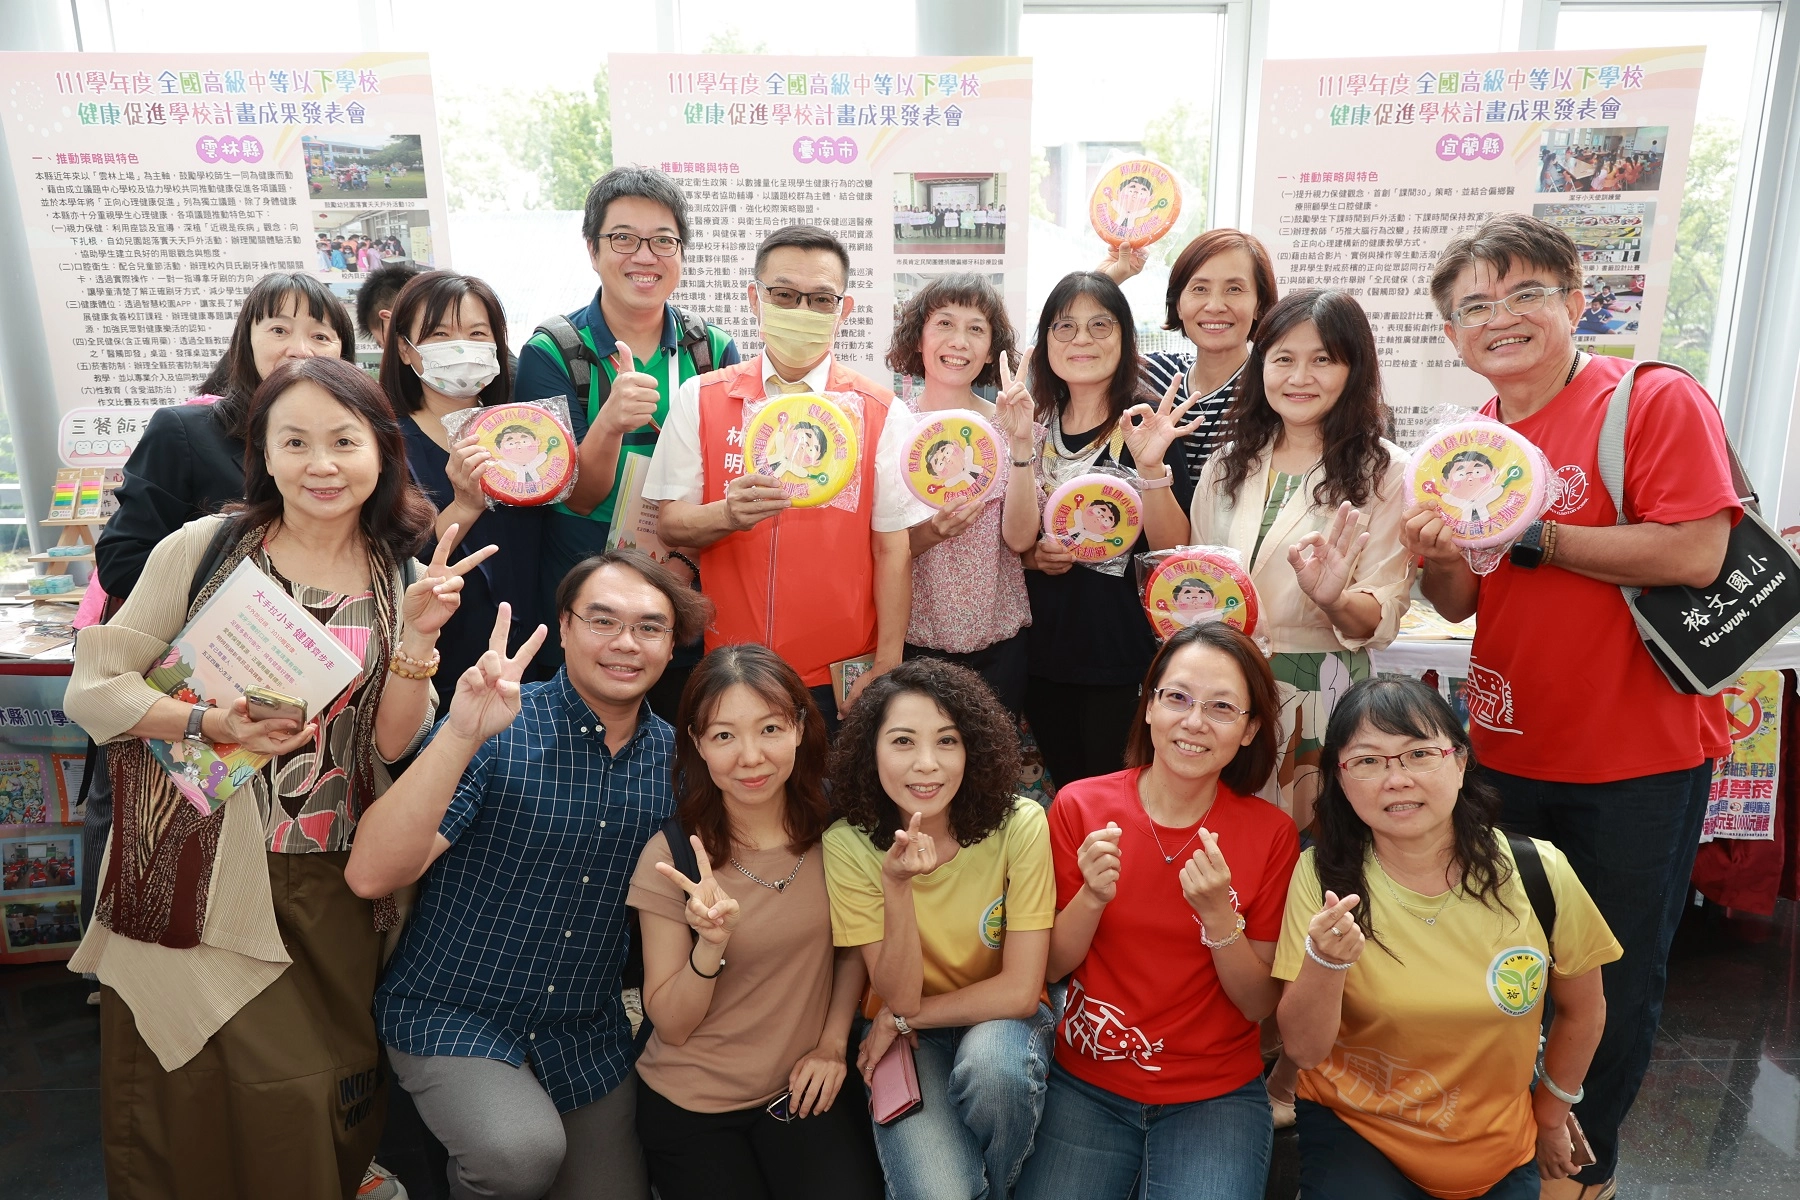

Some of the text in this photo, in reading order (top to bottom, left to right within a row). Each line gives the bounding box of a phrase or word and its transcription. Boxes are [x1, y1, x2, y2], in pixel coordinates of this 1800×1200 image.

[56, 70, 380, 95] 111學年度全國高級中等以下學校
[668, 72, 981, 97] 111學年度全國高級中等以下學校
[1318, 65, 1645, 97] 111學年度全國高級中等以下學校
[77, 101, 367, 126] 健康促進學校計畫成果發表會
[684, 103, 964, 127] 健康促進學校計畫成果發表會
[1329, 96, 1622, 126] 健康促進學校計畫成果發表會
[32, 152, 140, 165] 一、推動策略與特色
[199, 138, 262, 159] 雲林縣
[797, 139, 855, 159] 臺南市
[1440, 136, 1500, 156] 宜蘭縣
[1277, 171, 1379, 184] 一、推動策略與特色
[724, 426, 745, 499] 林明
[1681, 554, 1768, 633] 裕文國小
[1699, 571, 1787, 648] YU-WUN, TAINAN
[252, 589, 336, 671] 大手拉小手 健康齊步走
[0, 708, 77, 727] 縣111學
